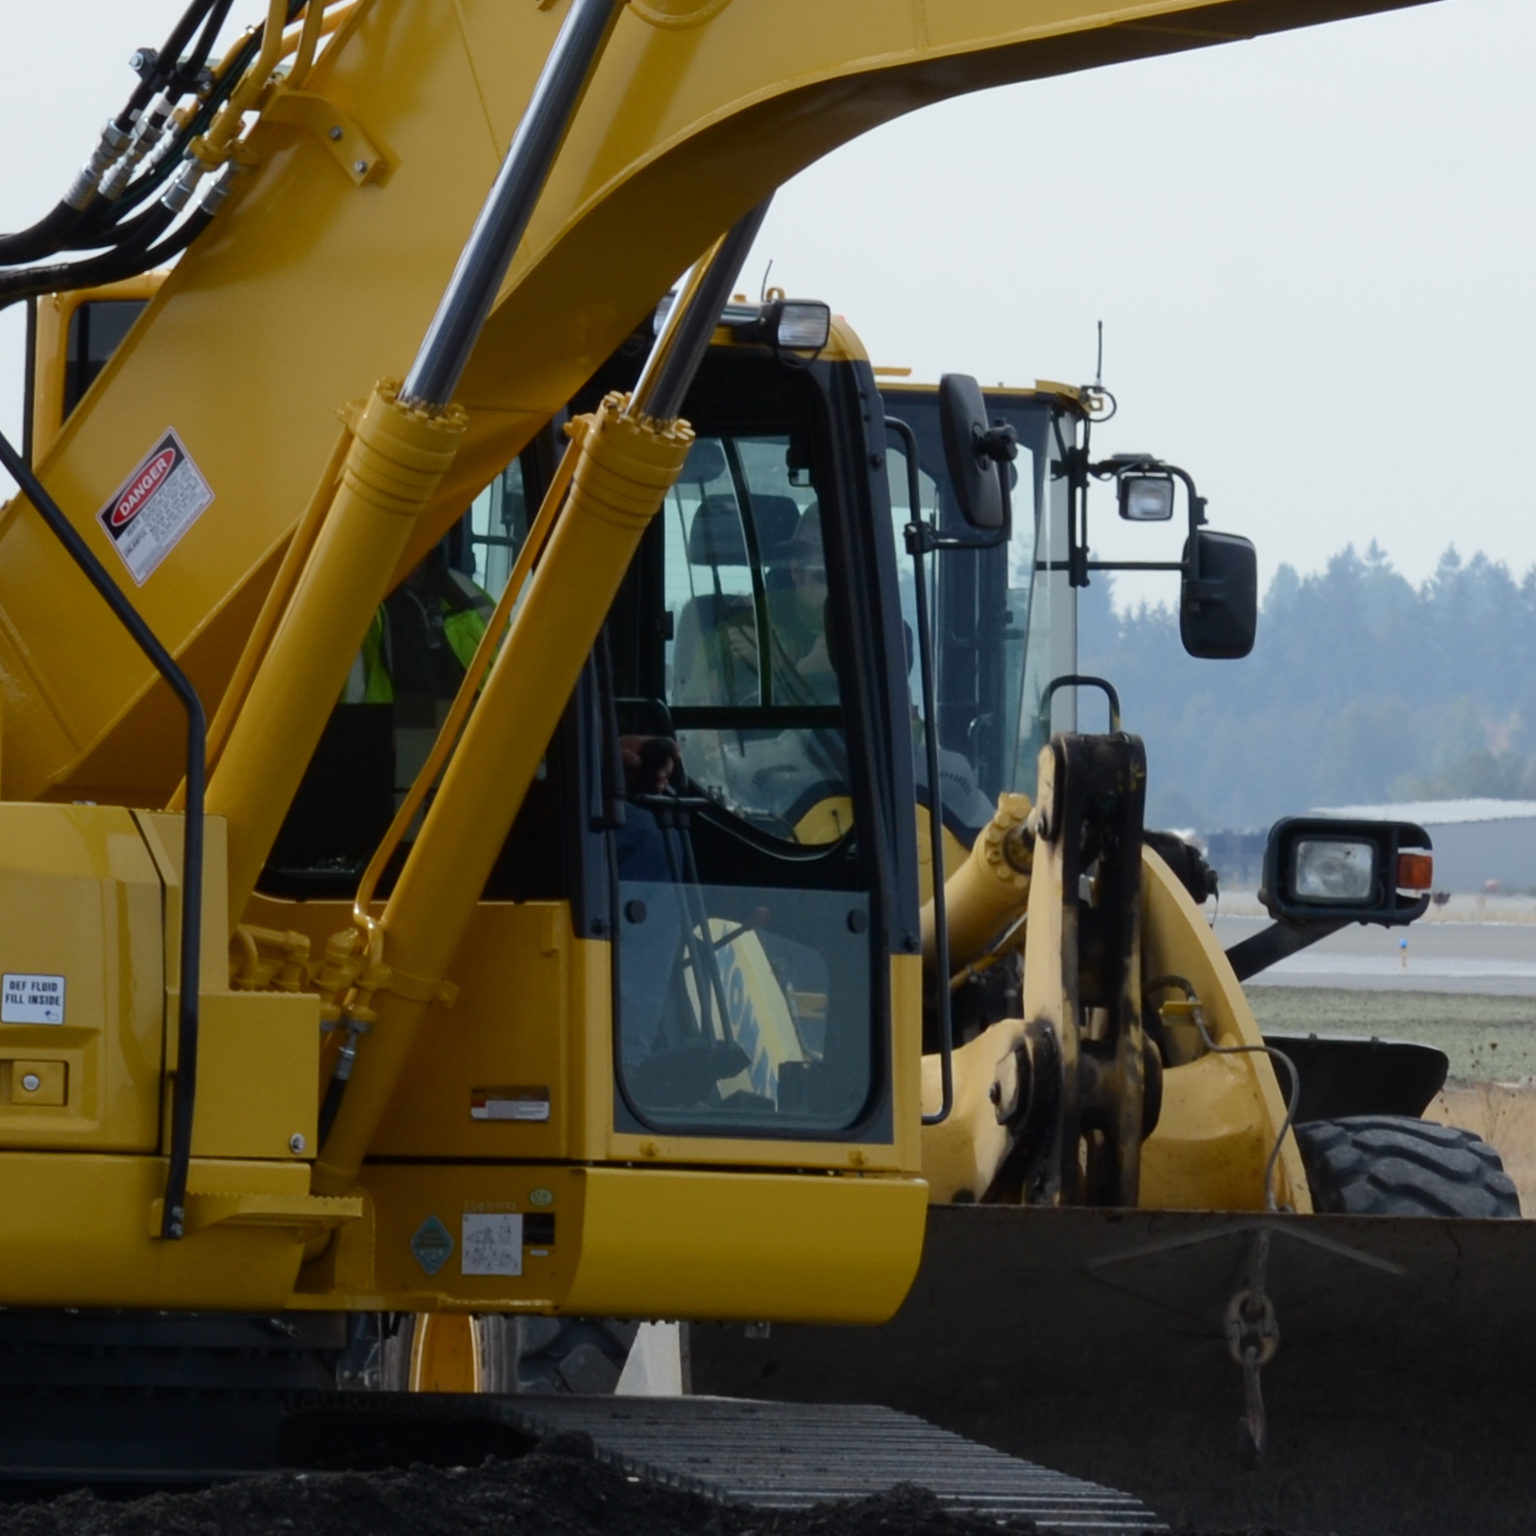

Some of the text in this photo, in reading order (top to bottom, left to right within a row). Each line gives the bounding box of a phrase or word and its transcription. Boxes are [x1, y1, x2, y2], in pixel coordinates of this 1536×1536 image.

[119, 457, 168, 516] DANGER
[9, 980, 58, 992] DEF FLUID
[5, 993, 61, 1006] FILL INSIDE
